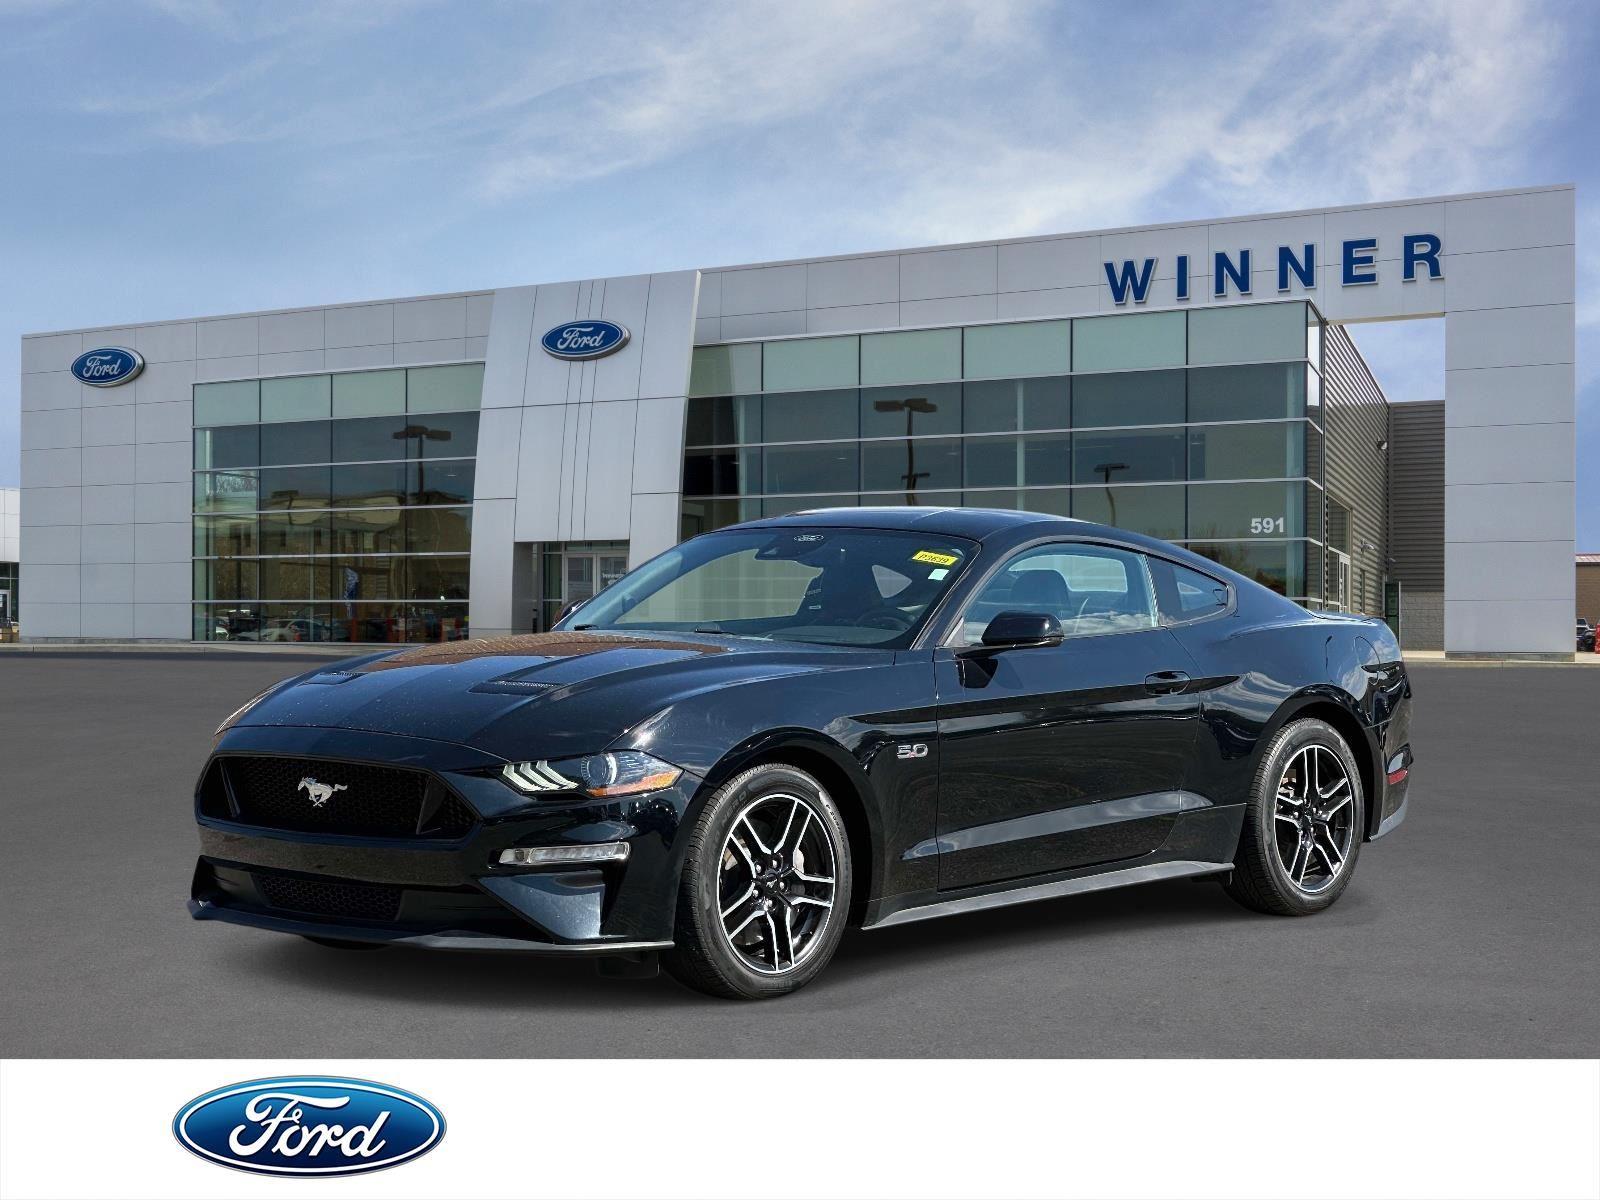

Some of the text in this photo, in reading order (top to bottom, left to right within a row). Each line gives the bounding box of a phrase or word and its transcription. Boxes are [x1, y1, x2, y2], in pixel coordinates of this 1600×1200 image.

[1103, 233, 1445, 306] WINNER
[558, 326, 606, 350] Ford
[82, 355, 122, 378] Ford
[1250, 517, 1285, 534] 591
